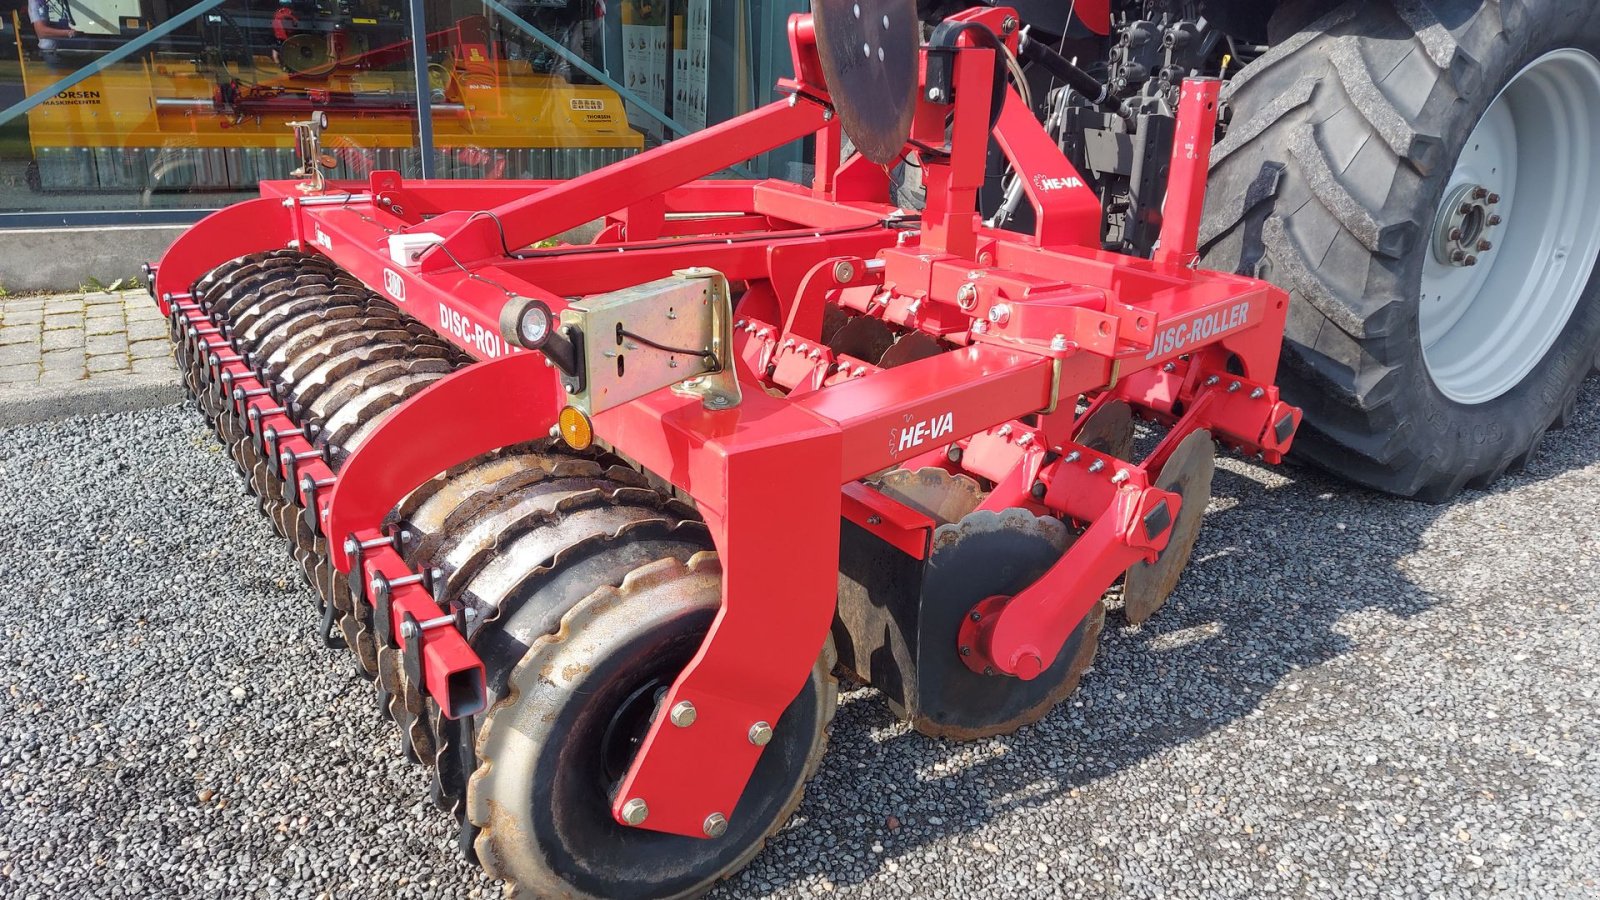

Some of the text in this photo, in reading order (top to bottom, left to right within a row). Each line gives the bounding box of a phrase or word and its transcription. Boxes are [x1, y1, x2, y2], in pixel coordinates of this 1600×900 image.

[1041, 176, 1083, 190] HE-VA
[386, 271, 402, 299] 300
[898, 411, 953, 452] HE-VA
